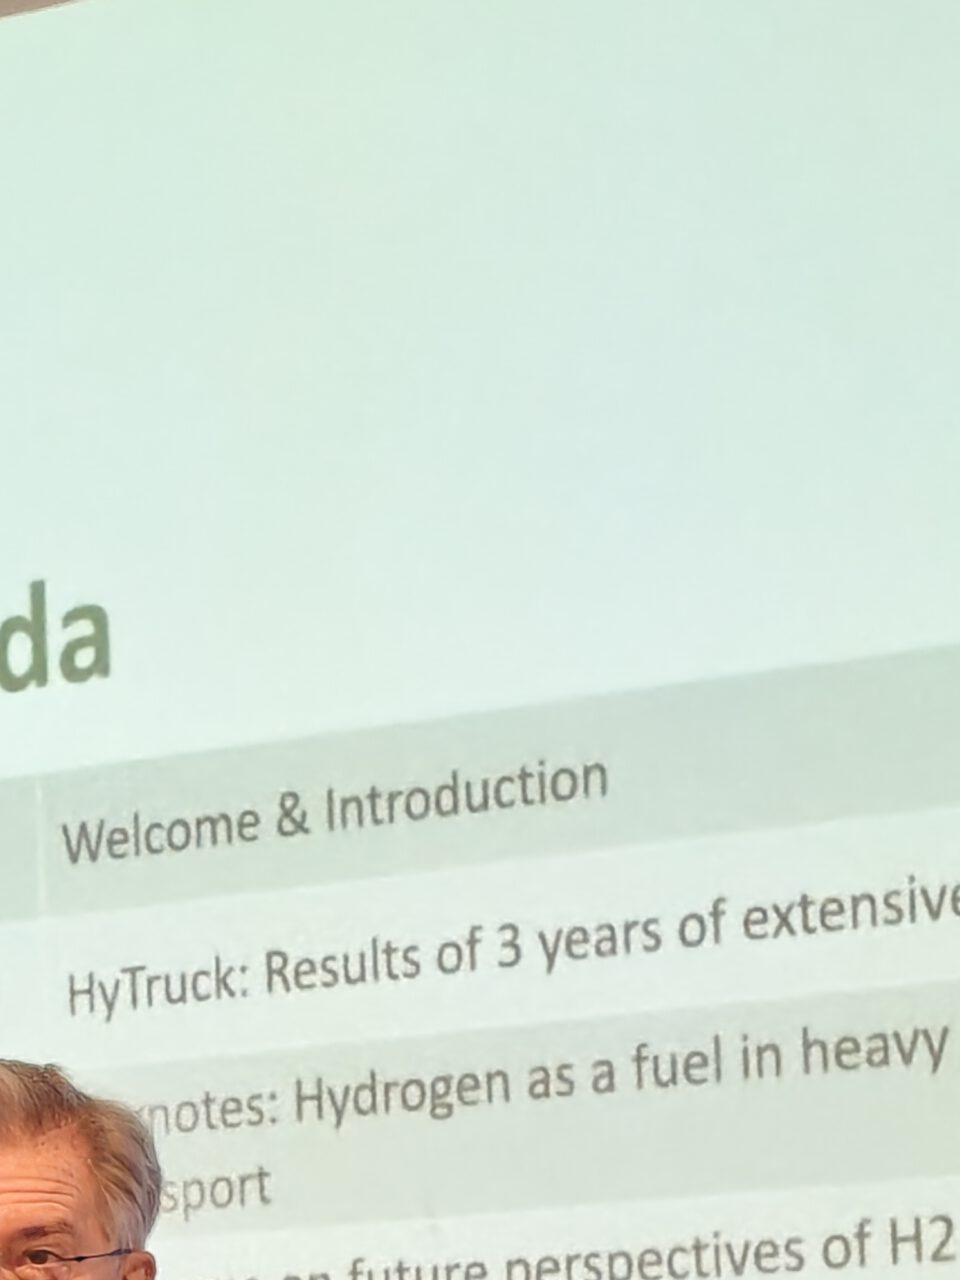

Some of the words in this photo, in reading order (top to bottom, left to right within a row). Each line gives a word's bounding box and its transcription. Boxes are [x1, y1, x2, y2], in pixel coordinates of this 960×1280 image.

[62, 807, 260, 865] Welcome
[276, 790, 309, 838] &
[326, 759, 609, 832] Introduction
[68, 952, 249, 1024] HyTruck:
[265, 937, 421, 992] Results
[436, 926, 483, 976] of
[497, 923, 523, 969] 3
[539, 917, 663, 974] years
[678, 897, 726, 948] of
[295, 1067, 511, 1129] Hydrogen
[527, 1060, 575, 1100] as
[591, 1058, 616, 1096] a
[632, 1034, 723, 1090] fuel
[741, 1034, 782, 1079] in
[802, 1025, 949, 1074] heavy
[821, 1218, 871, 1270] of
[890, 1214, 957, 1265] H2
